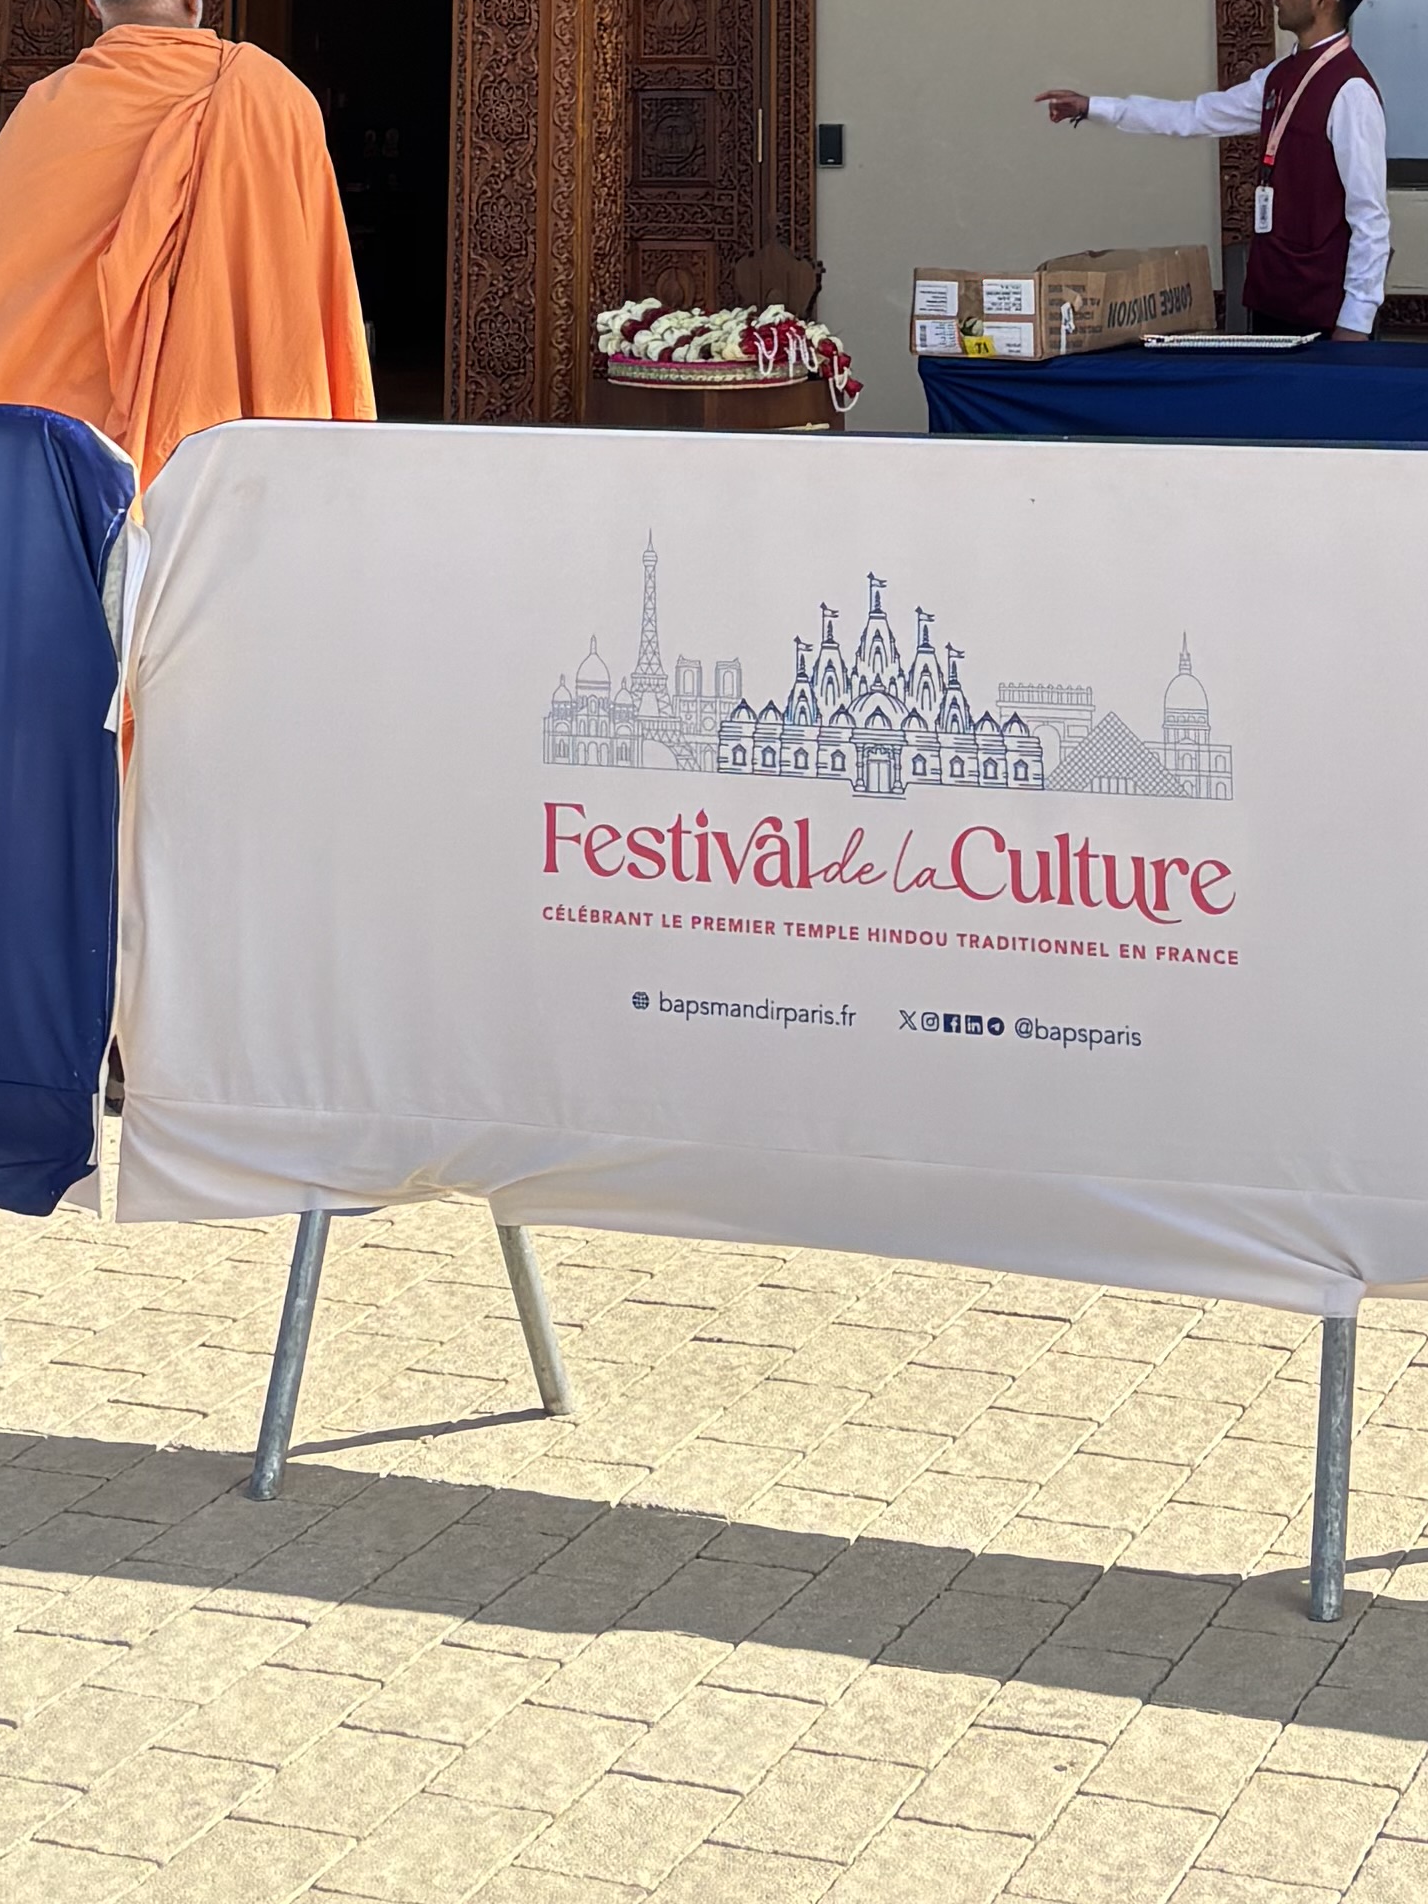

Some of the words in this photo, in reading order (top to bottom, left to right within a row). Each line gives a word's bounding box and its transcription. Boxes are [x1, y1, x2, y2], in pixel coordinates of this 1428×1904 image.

[543, 801, 813, 889] Festival
[810, 827, 888, 886] de
[893, 828, 959, 893] la
[950, 825, 1237, 925] Culture
[542, 903, 654, 928] CÉLÉBRANT
[661, 913, 683, 930] LE
[691, 916, 776, 936] PREMIER
[783, 921, 860, 941] TEMPLE
[868, 927, 948, 947] HINDOU
[956, 933, 1110, 958] TRADITIONNEL
[1119, 943, 1146, 960] EN
[1156, 946, 1240, 965] FRANCE
[658, 991, 857, 1030] bapsmandirparis.fr
[1013, 1017, 1143, 1050] @bapsparis
